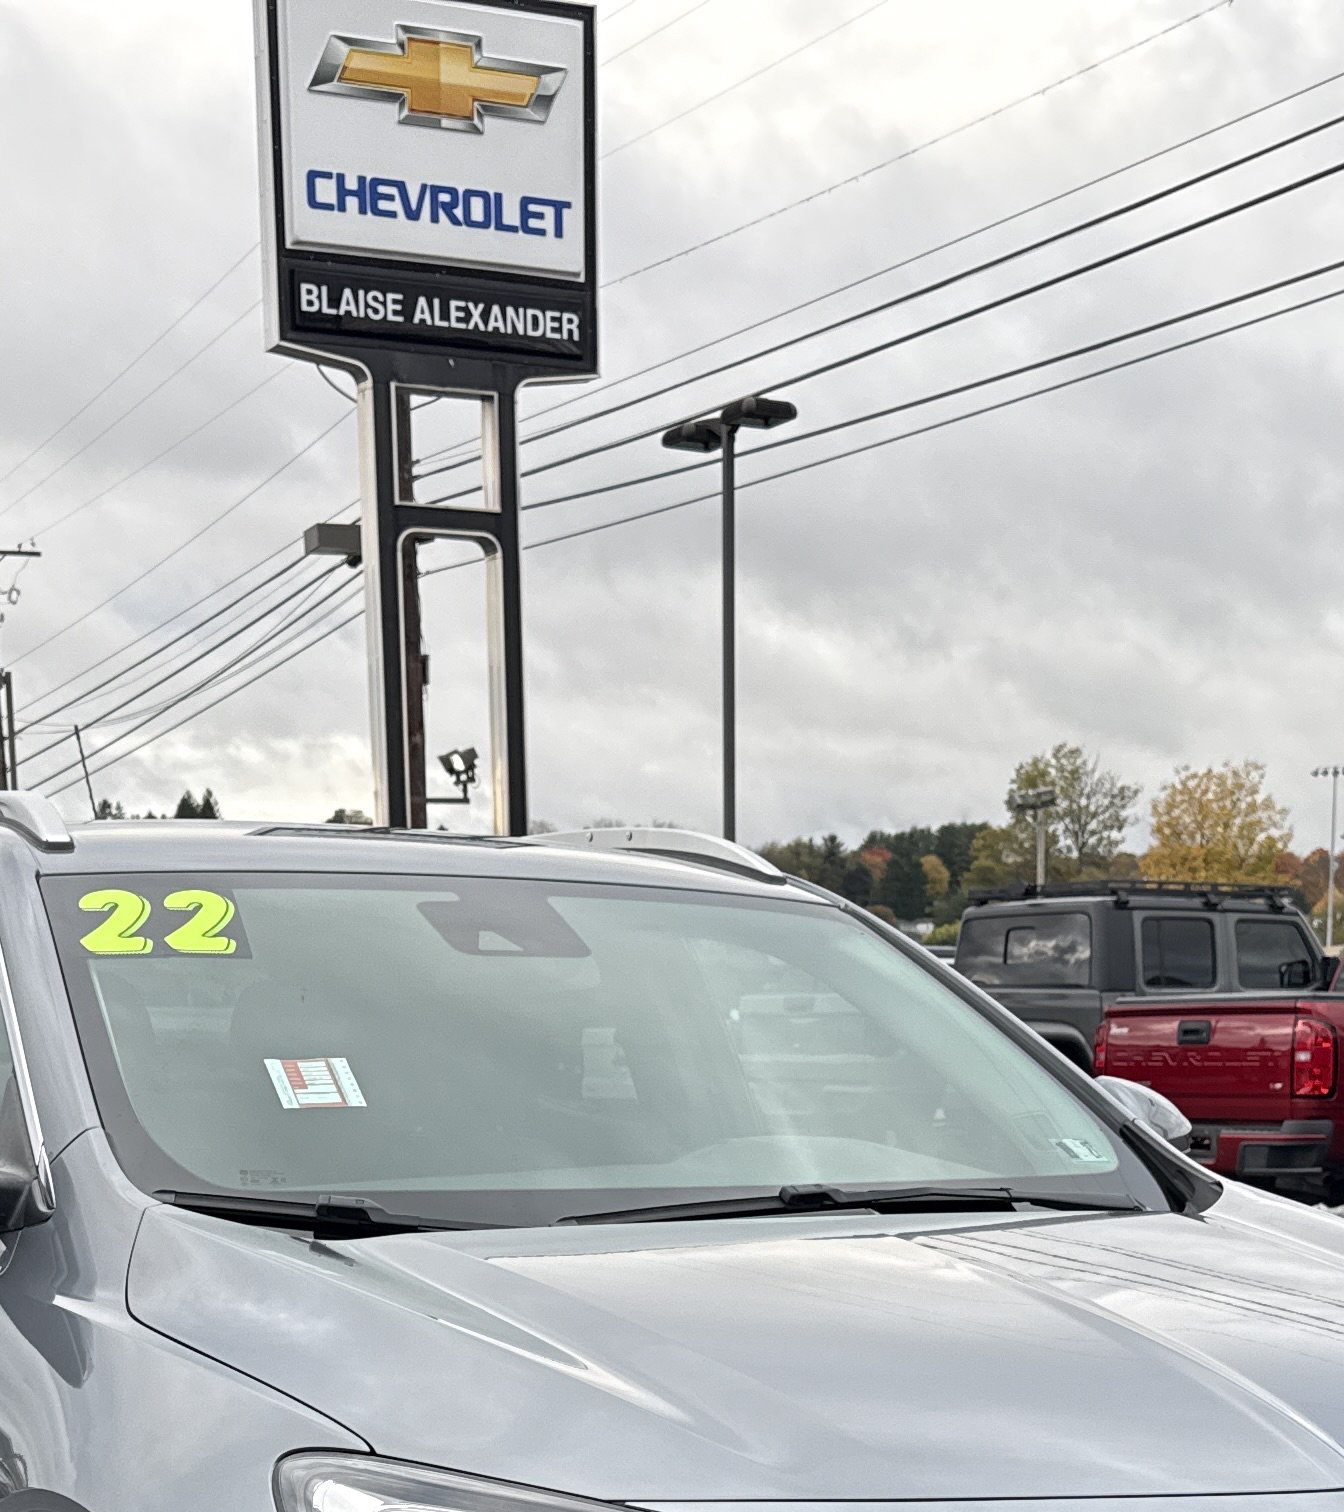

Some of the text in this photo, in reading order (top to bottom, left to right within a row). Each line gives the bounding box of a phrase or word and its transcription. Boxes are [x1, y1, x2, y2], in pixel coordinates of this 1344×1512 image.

[306, 170, 572, 239] CHEVROLET
[300, 283, 580, 342] BLAISE ALEXANDER
[78, 889, 237, 955] 22
[1112, 1050, 1282, 1067] CHEVROLET
